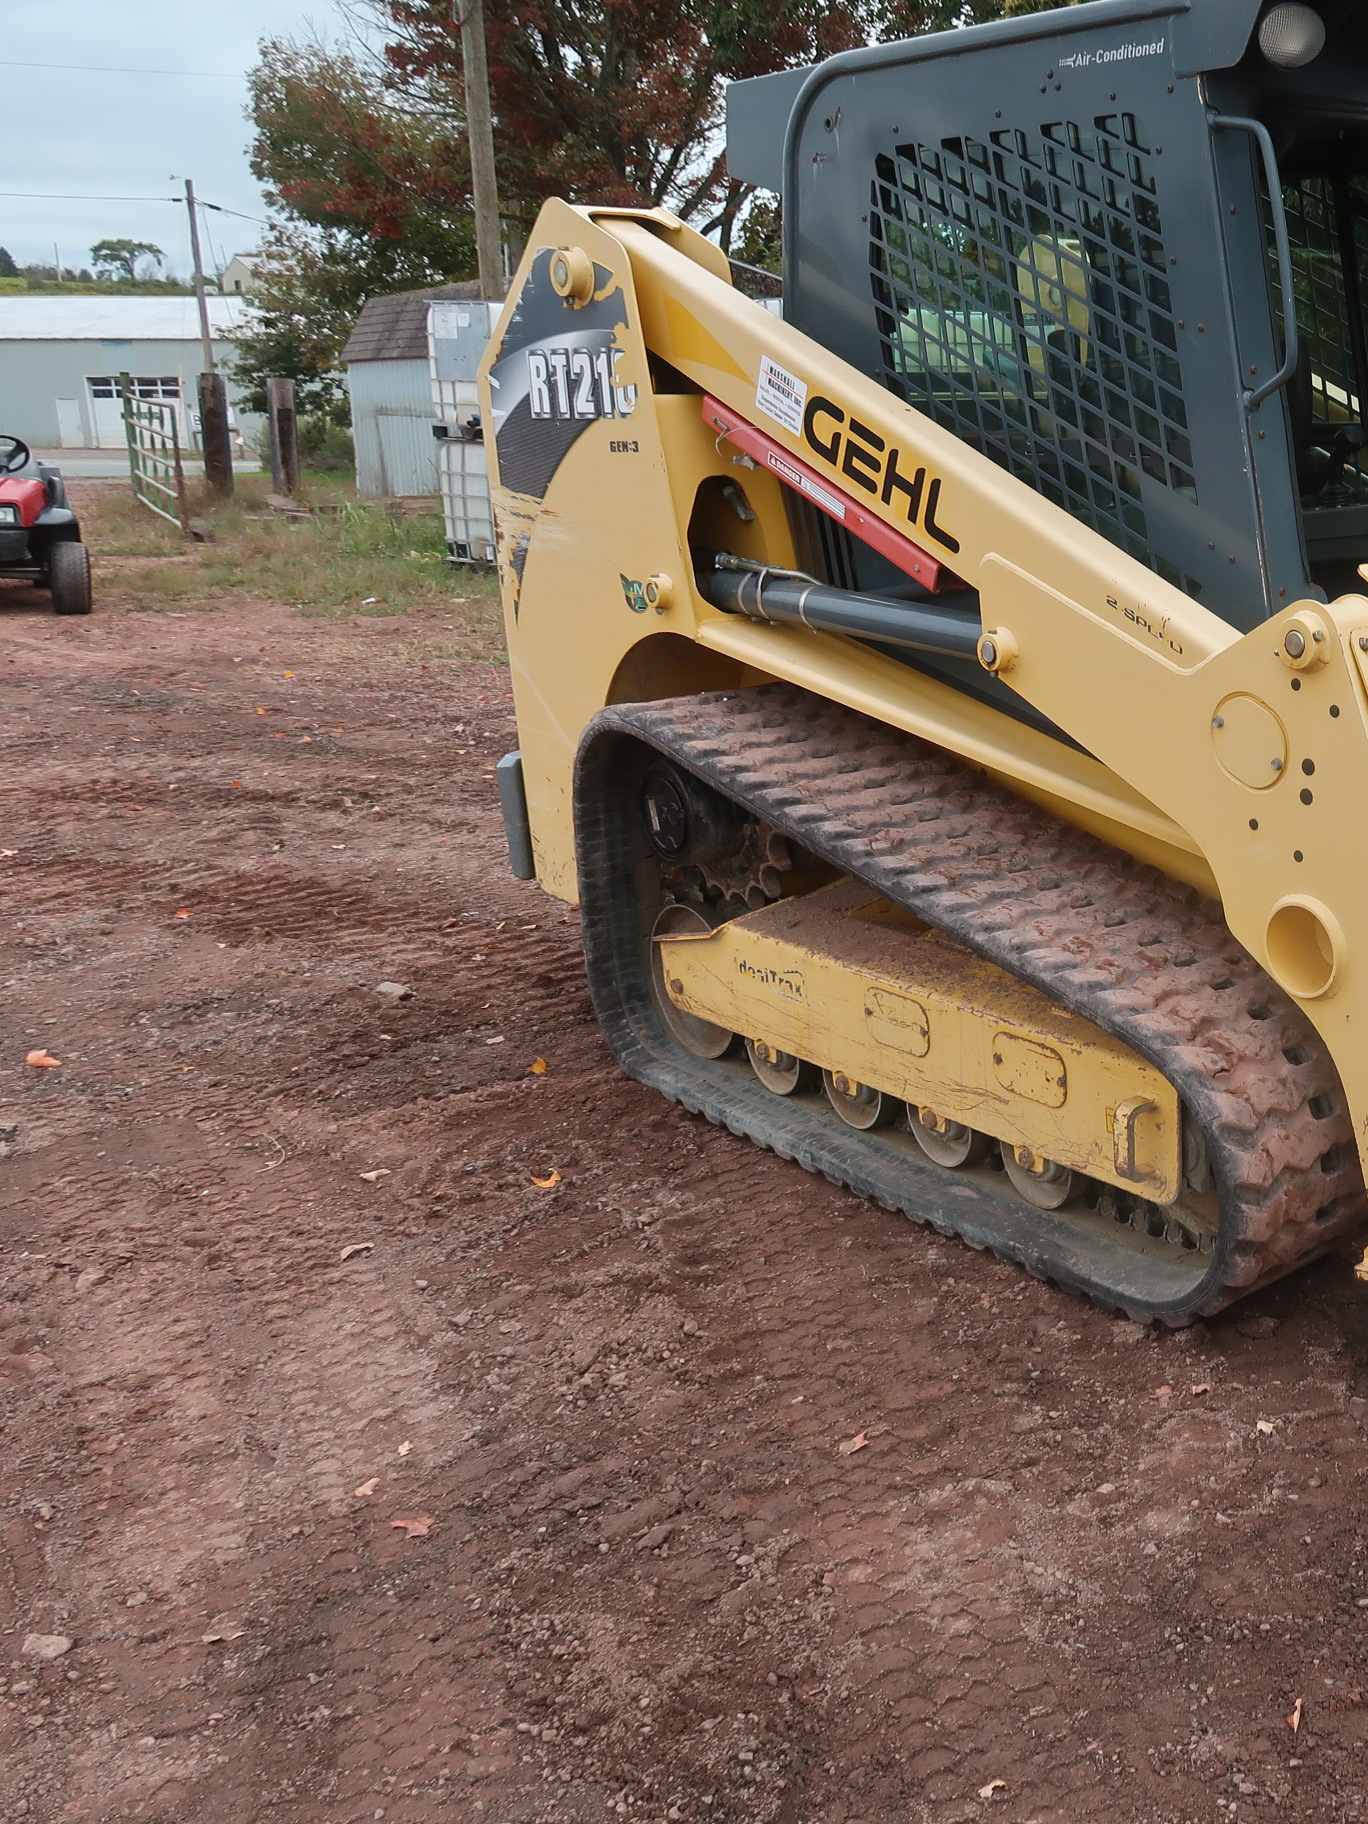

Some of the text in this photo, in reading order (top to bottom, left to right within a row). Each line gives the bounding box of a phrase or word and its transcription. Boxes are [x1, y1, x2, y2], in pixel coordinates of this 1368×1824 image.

[1075, 38, 1165, 68] Air-Conditioned
[769, 365, 795, 389] MARSHALL
[610, 441, 639, 452] GEN:3
[776, 461, 801, 484] DANGER
[804, 396, 960, 554] GEHL
